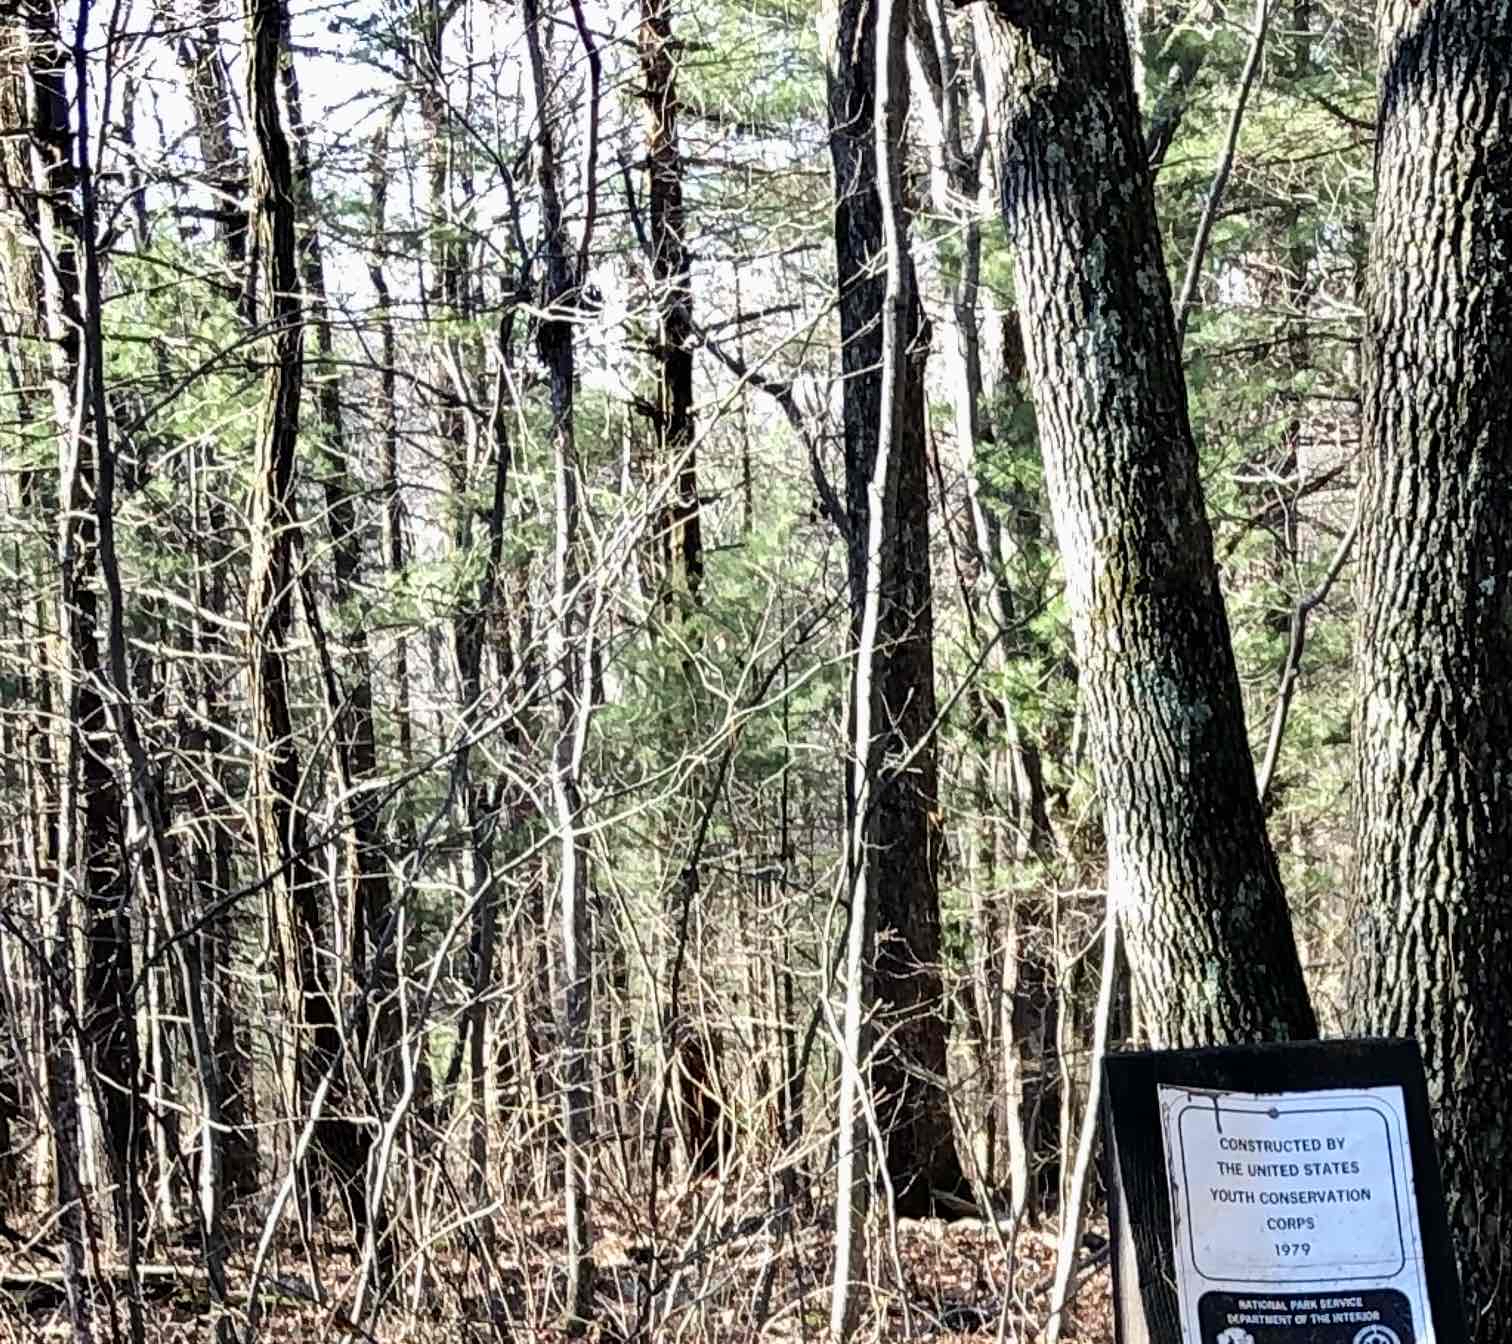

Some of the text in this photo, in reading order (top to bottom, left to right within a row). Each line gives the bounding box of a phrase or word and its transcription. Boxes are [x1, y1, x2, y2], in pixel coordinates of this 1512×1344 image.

[1219, 1136, 1346, 1153] CONSTRUCTED BY
[1217, 1161, 1360, 1177] THE UNITED STATES
[1209, 1188, 1371, 1205] YOUTH CONSERVATION
[1266, 1217, 1315, 1231] CORPS
[1274, 1243, 1311, 1257] 1979
[1238, 1297, 1363, 1311] NATIONAL PARK SERVICE
[1227, 1310, 1380, 1325] DEPARTMENT OF THE INTERIOR
